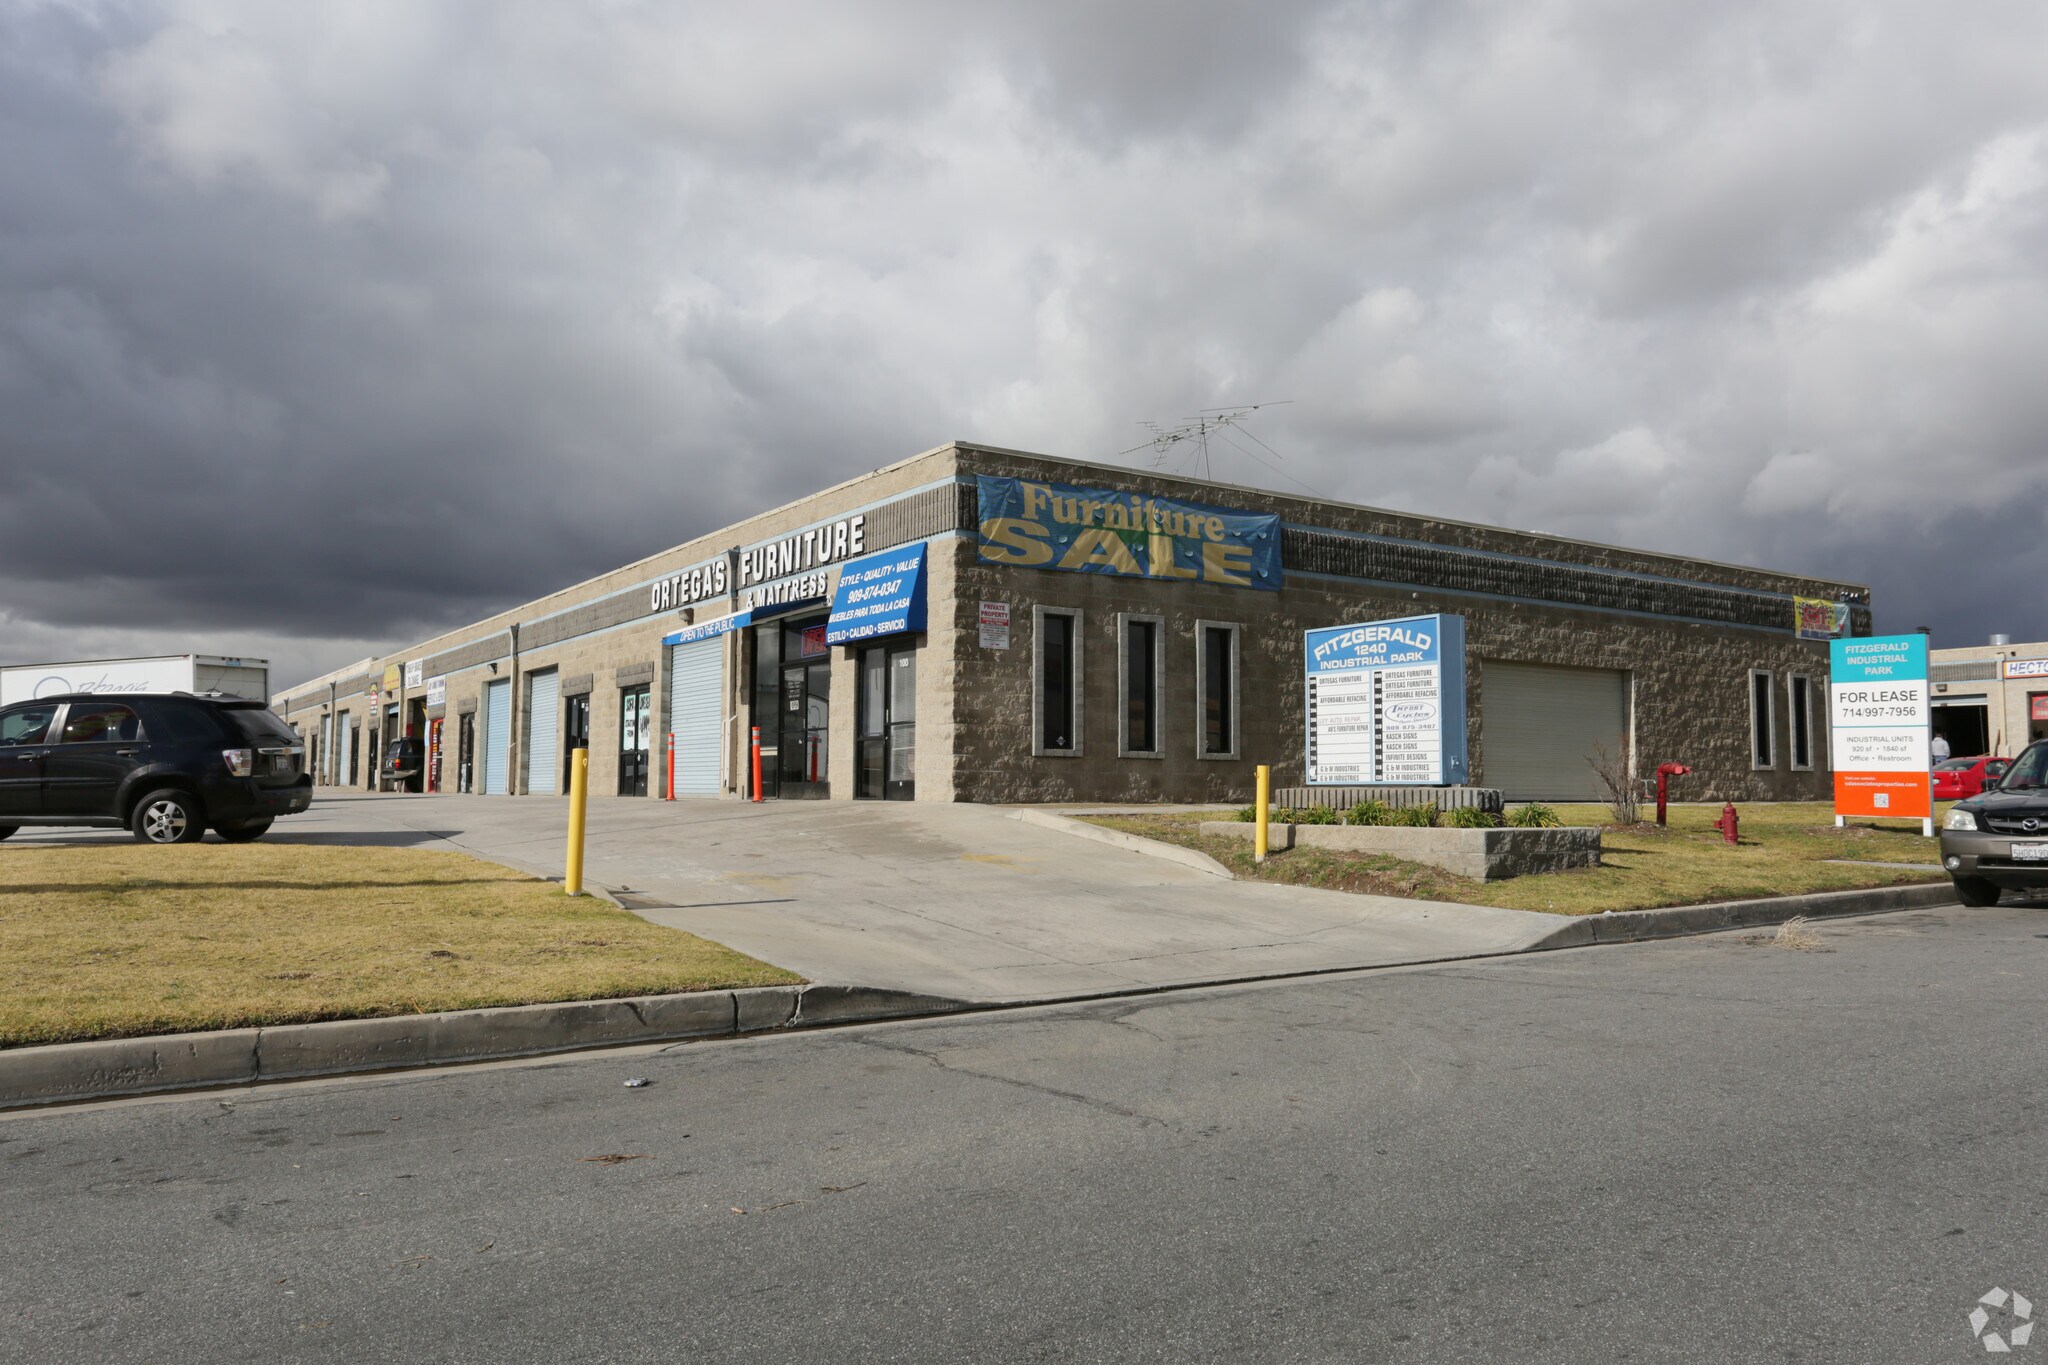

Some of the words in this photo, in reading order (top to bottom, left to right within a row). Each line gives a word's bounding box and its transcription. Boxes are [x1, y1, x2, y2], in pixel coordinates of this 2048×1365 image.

[1020, 481, 1225, 541] Furniture
[741, 515, 865, 585] FURNITURE
[978, 518, 1253, 586] SALE
[840, 573, 860, 587] STYLE
[864, 564, 893, 581] QUALITY
[896, 557, 919, 573] VALUE
[651, 560, 726, 611] ORTEGA'S
[757, 571, 827, 608] MATTRESS
[847, 579, 902, 604] 909-874-0347
[829, 611, 854, 623] MUEBLES
[854, 607, 868, 618] PARA
[869, 602, 885, 615] TODA
[885, 601, 893, 611] LA
[893, 597, 910, 610] CASA
[680, 629, 695, 641] OPEN
[695, 626, 704, 638] TO
[704, 622, 714, 636] THE
[714, 617, 735, 633] PUBLIC
[828, 630, 846, 643] ESTILO
[849, 624, 873, 638] CALIDAD
[877, 618, 905, 633] SERVICIO
[1313, 626, 1431, 661] FITZGERALD
[1354, 643, 1387, 655] 1240
[1845, 642, 1909, 654] FITZGERALD
[899, 658, 909, 668] 100
[1320, 655, 1387, 670] INDUSTRIAL
[1391, 651, 1423, 663] PARK
[1847, 654, 1908, 665] INDUSTRIAL
[1385, 671, 1405, 680] ORTEGAS
[1406, 669, 1432, 677] FURNITURE
[1865, 666, 1893, 675] PARK
[1319, 677, 1337, 685] ORTEGAS
[1338, 675, 1362, 683] FURNITURE
[1385, 681, 1405, 689] ORTEGAS
[1407, 679, 1432, 688] FURNITURE
[1386, 691, 1414, 699] AFFORDABLE
[1414, 690, 1437, 698] REFACING
[1839, 692, 1868, 703] FOR
[1871, 690, 1918, 702] LEASE
[1842, 706, 1916, 717] 714/997-7956
[1337, 724, 1356, 733] FURNITURE
[1402, 732, 1418, 740] SIGNS
[1386, 743, 1402, 751] KASCH
[1334, 774, 1360, 782] INDUSTRIES
